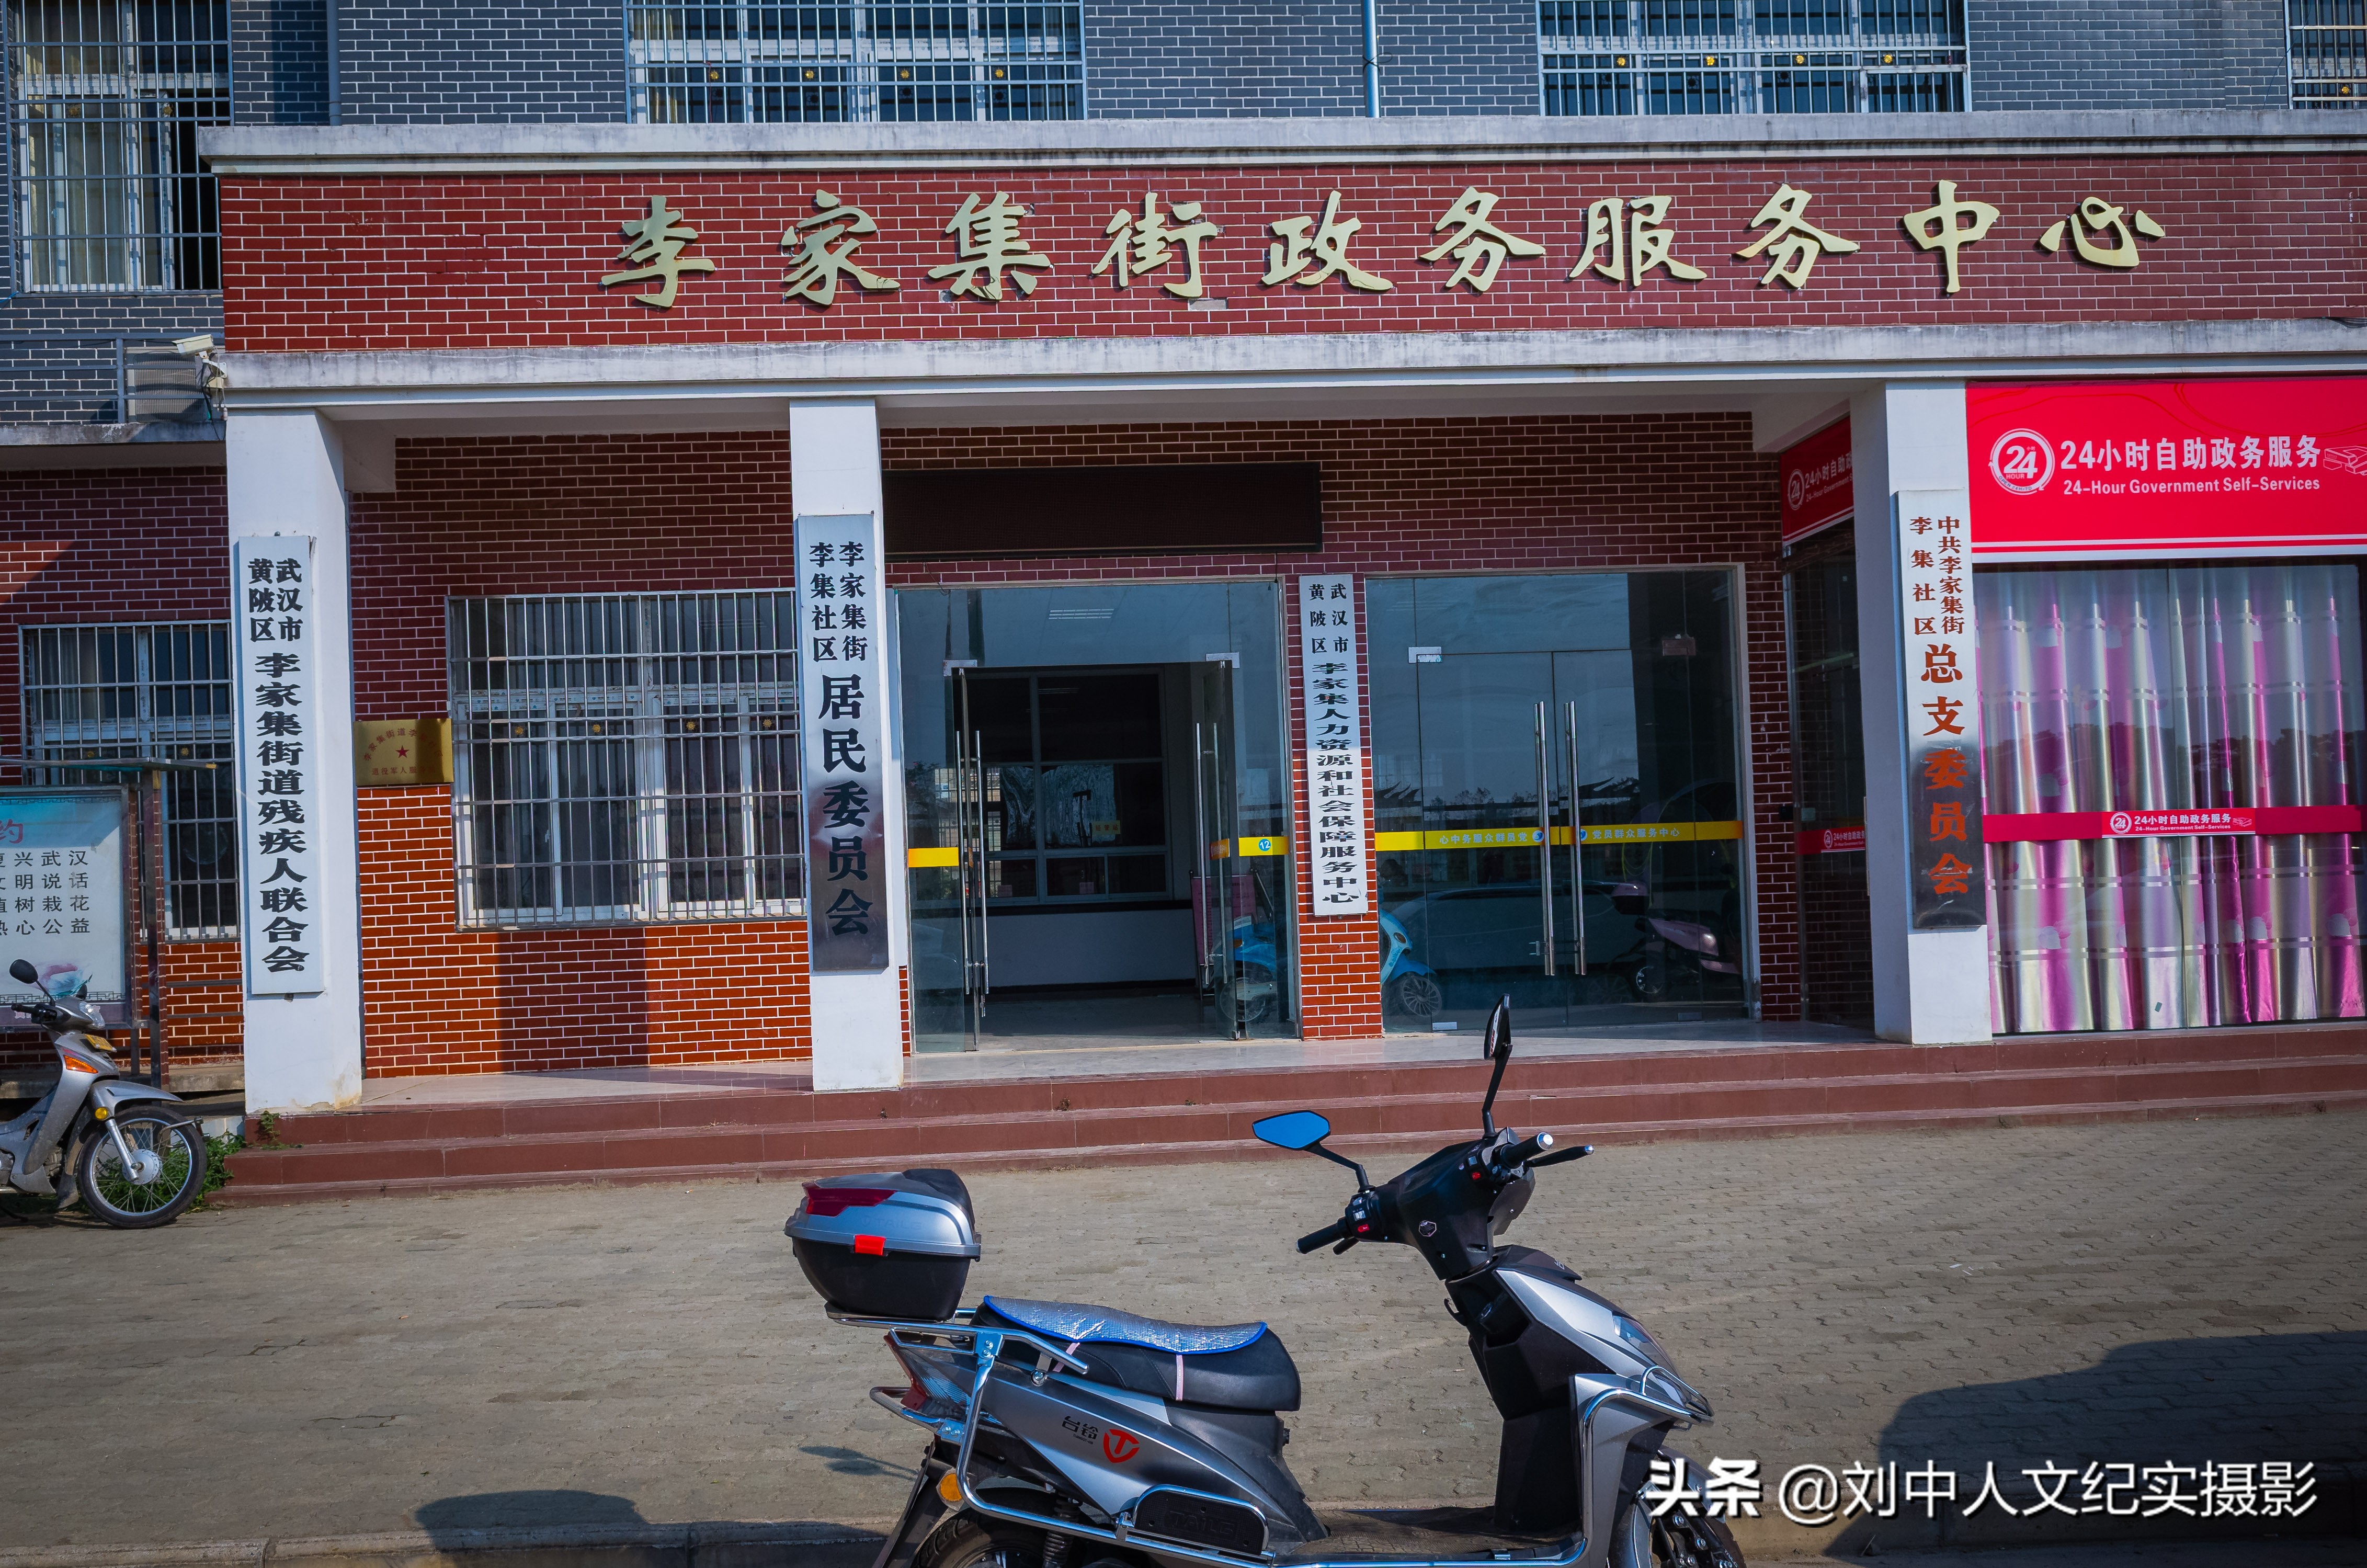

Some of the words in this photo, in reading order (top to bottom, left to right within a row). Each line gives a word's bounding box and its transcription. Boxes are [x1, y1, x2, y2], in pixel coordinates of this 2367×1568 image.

[601, 179, 2166, 307] 李家集街政务服务中心
[2061, 435, 2320, 471] 24小时自助政务服务
[2064, 480, 2126, 495] 24-Hour
[2130, 479, 2220, 493] Government
[2223, 476, 2320, 491] Self-Services
[247, 558, 276, 643] 黄陂区
[276, 558, 303, 642] 武汉市
[809, 542, 838, 663] 李集社区
[839, 541, 868, 661] 李家集街
[1909, 516, 1937, 635] 李集社区
[1937, 515, 1964, 635] 中共李家集街
[1308, 584, 1327, 654] 黄陂区
[1330, 584, 1349, 654] 武汉市
[818, 674, 873, 936] 居民委员会
[1312, 662, 1360, 903] 李家集人力资源和社会保障服务中心
[1921, 644, 1972, 894] 总支委员会
[255, 652, 310, 973] 李家集街道残疾人联合会
[1259, 840, 1271, 849] 12
[1592, 827, 1680, 839] 党员群众服务中心
[2134, 813, 2231, 825] 24小时自助政务服务
[1062, 1415, 1099, 1440] 台铃
